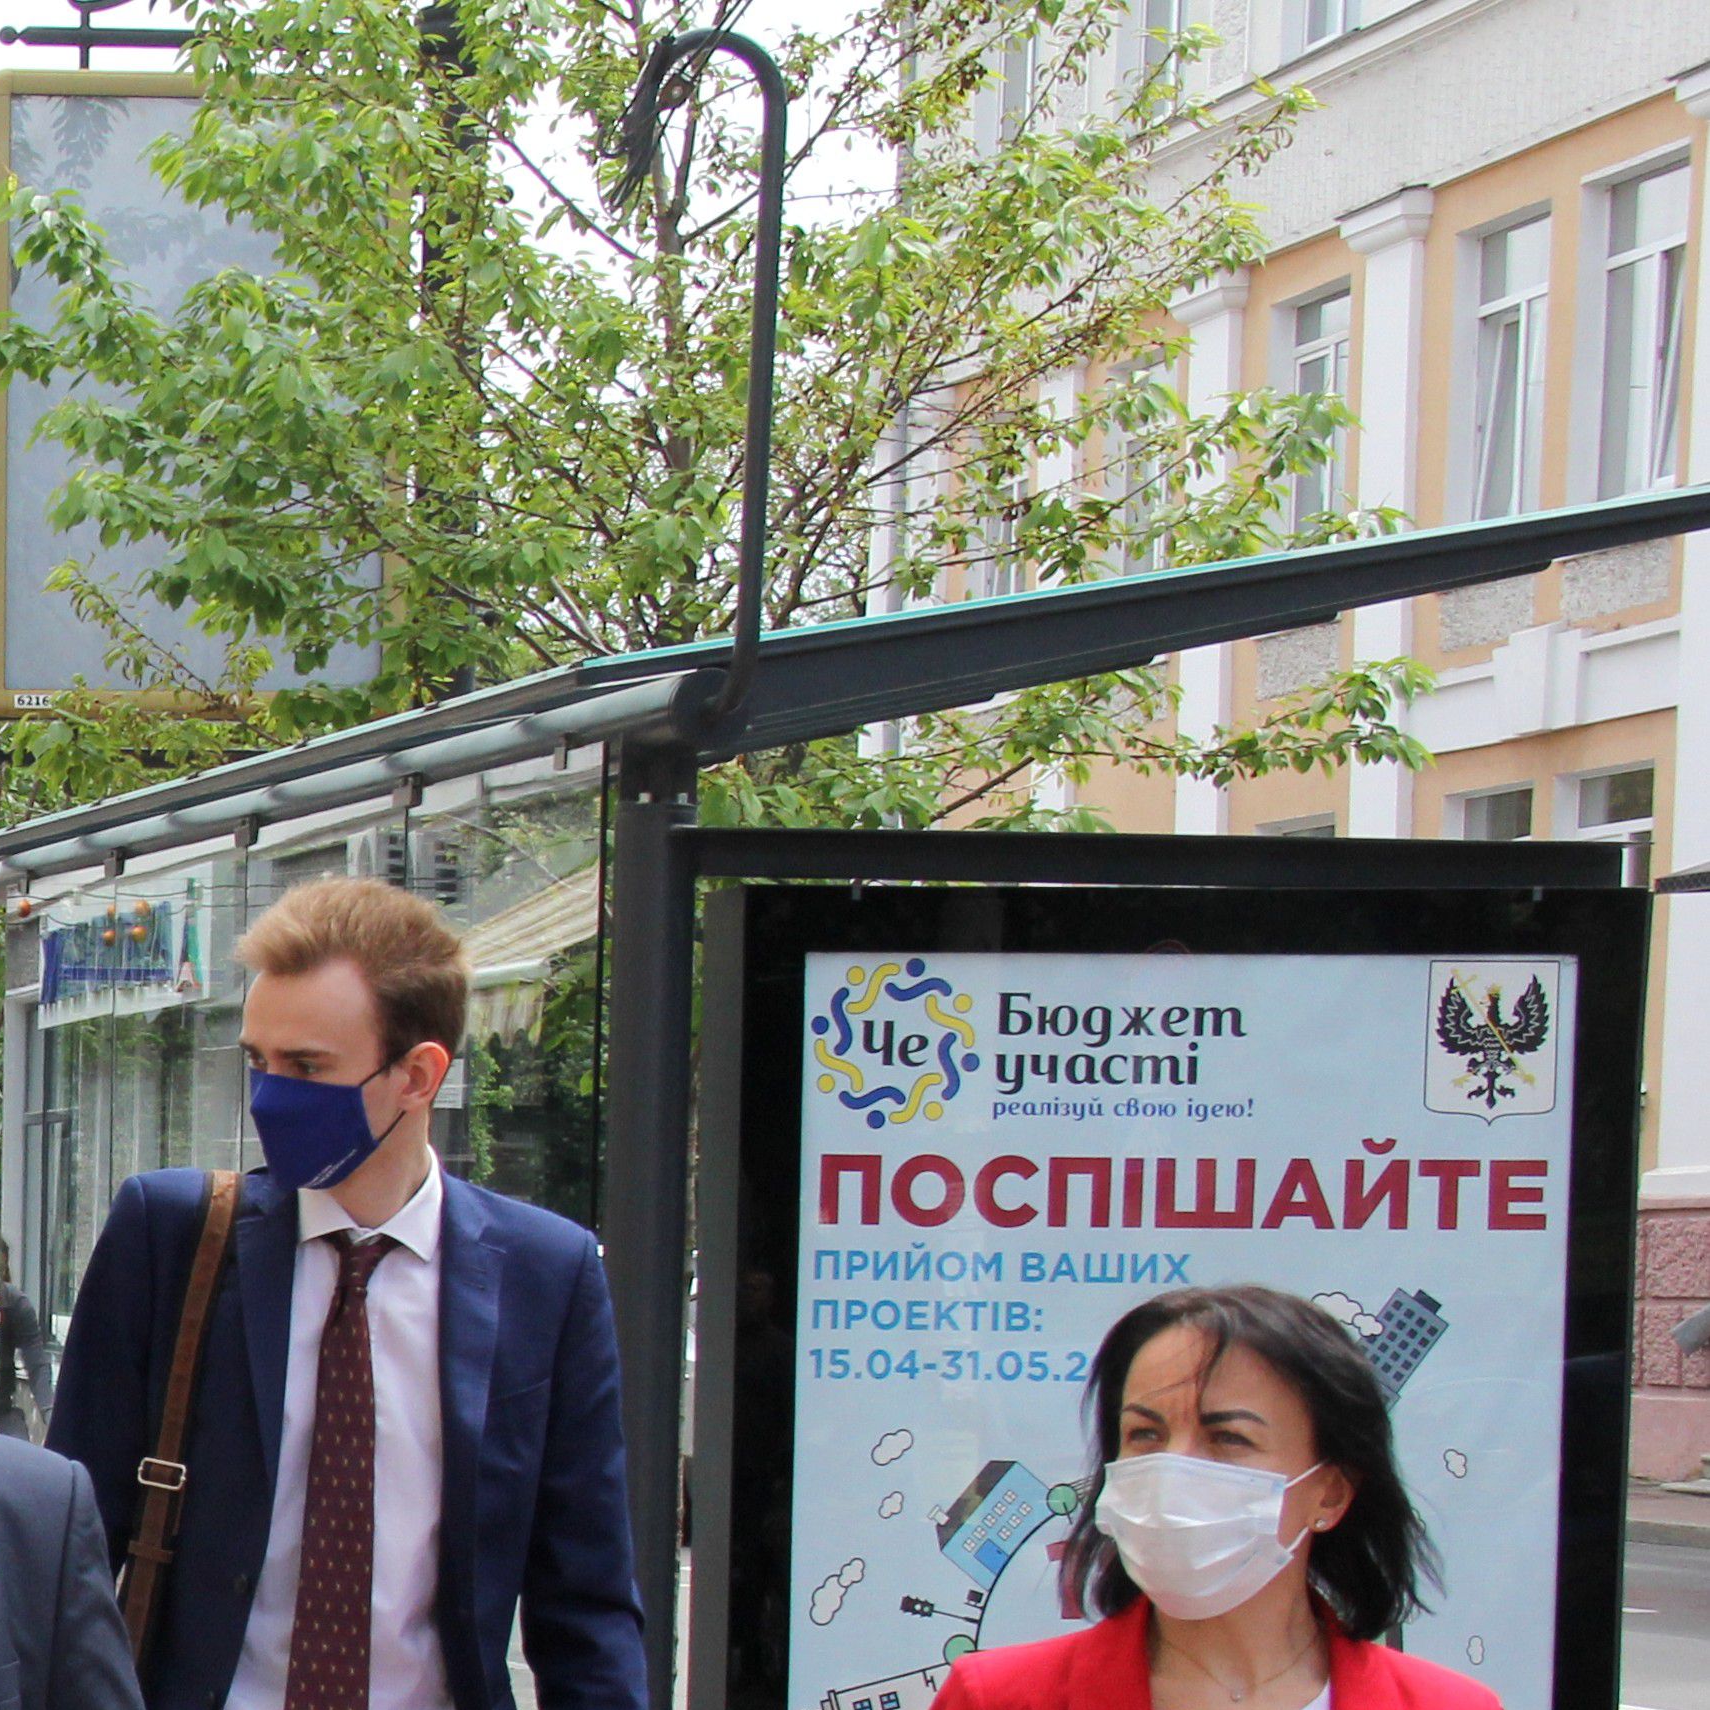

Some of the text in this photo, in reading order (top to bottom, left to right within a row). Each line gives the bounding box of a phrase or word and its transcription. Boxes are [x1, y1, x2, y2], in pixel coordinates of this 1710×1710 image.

[998, 992, 1247, 1047] Бюджет
[862, 1020, 929, 1068] Че
[995, 1041, 1199, 1095] участі
[992, 1097, 1255, 1122] реалізуй свою ідею!
[819, 1138, 1548, 1231] ПОСПІШАЙТЕ
[813, 1242, 1192, 1284] ПРИЙОМ ВАШИХ
[811, 1299, 1044, 1332] ПРОЕКТІВ:
[809, 1348, 1088, 1383] 15.04-31.05.2
